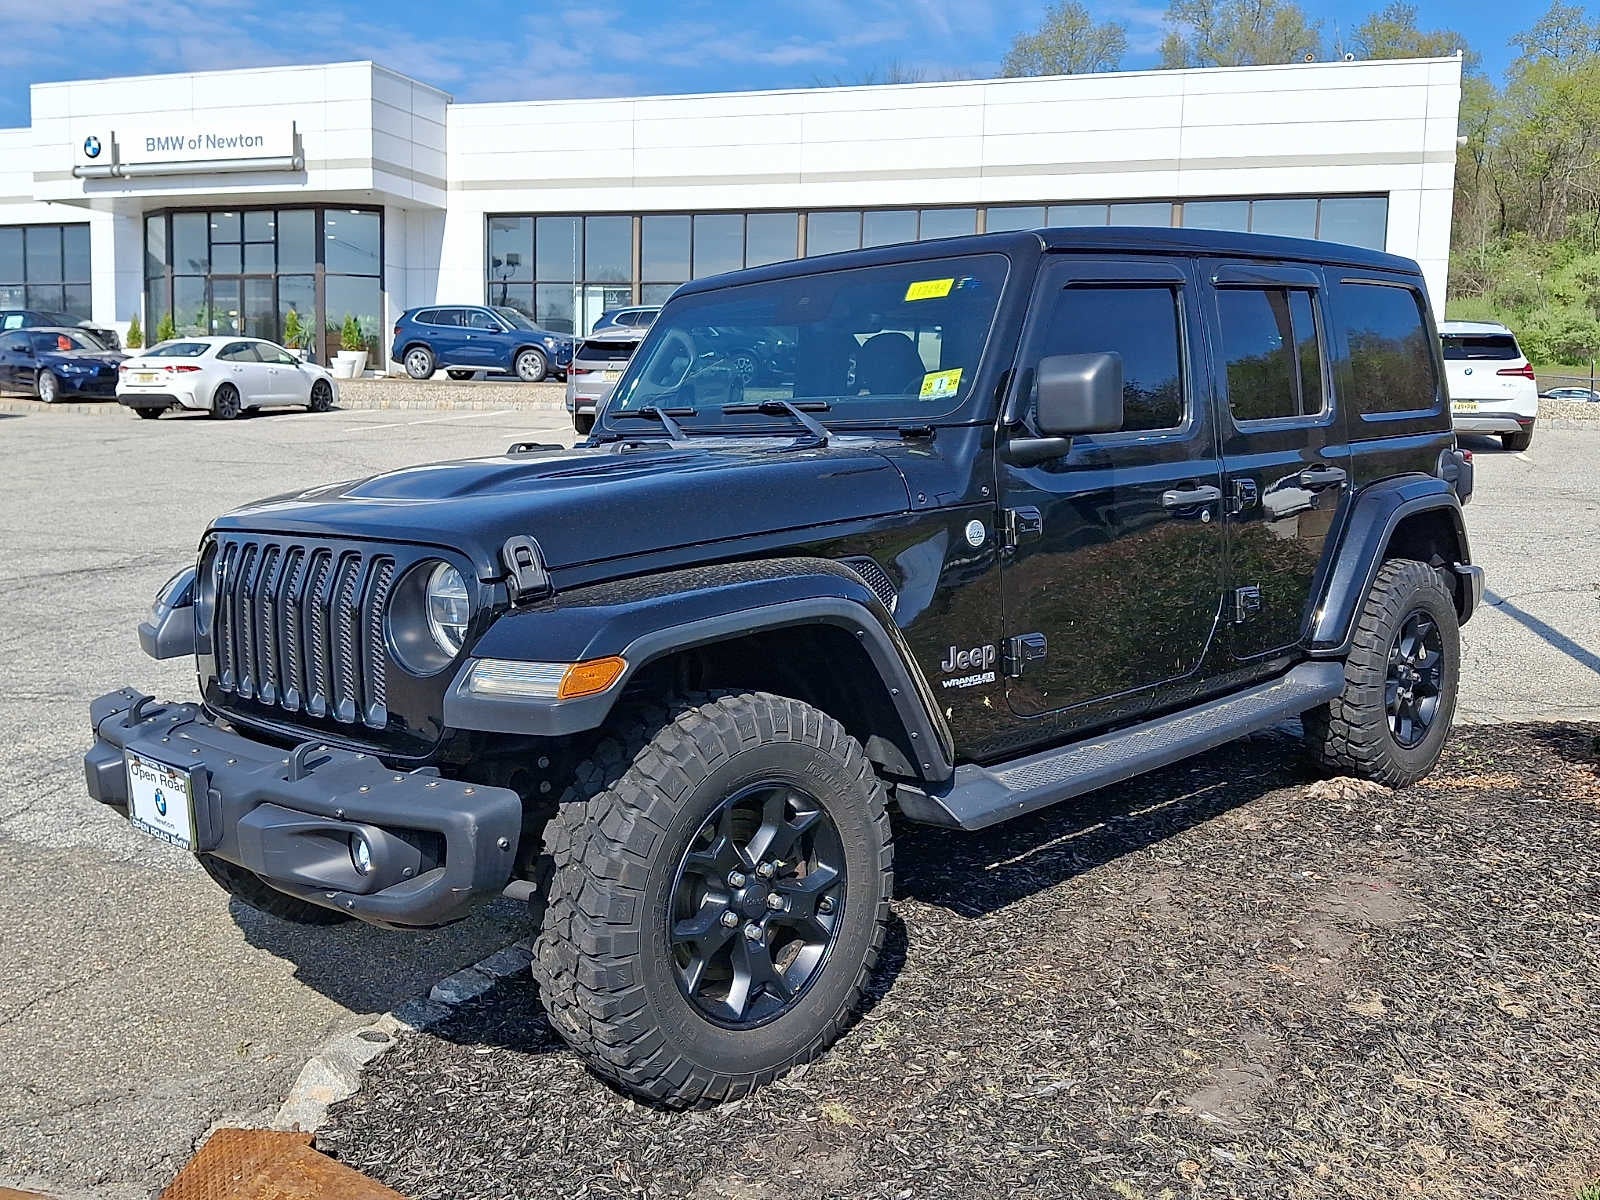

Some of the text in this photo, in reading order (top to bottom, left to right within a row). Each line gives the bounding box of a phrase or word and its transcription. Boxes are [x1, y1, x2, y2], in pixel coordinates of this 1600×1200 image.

[146, 133, 263, 151] BMW of Newton
[941, 644, 996, 673] Jeep
[942, 672, 995, 688] WRANGLER
[131, 764, 187, 794] Open Road
[151, 827, 170, 842] ROAD
